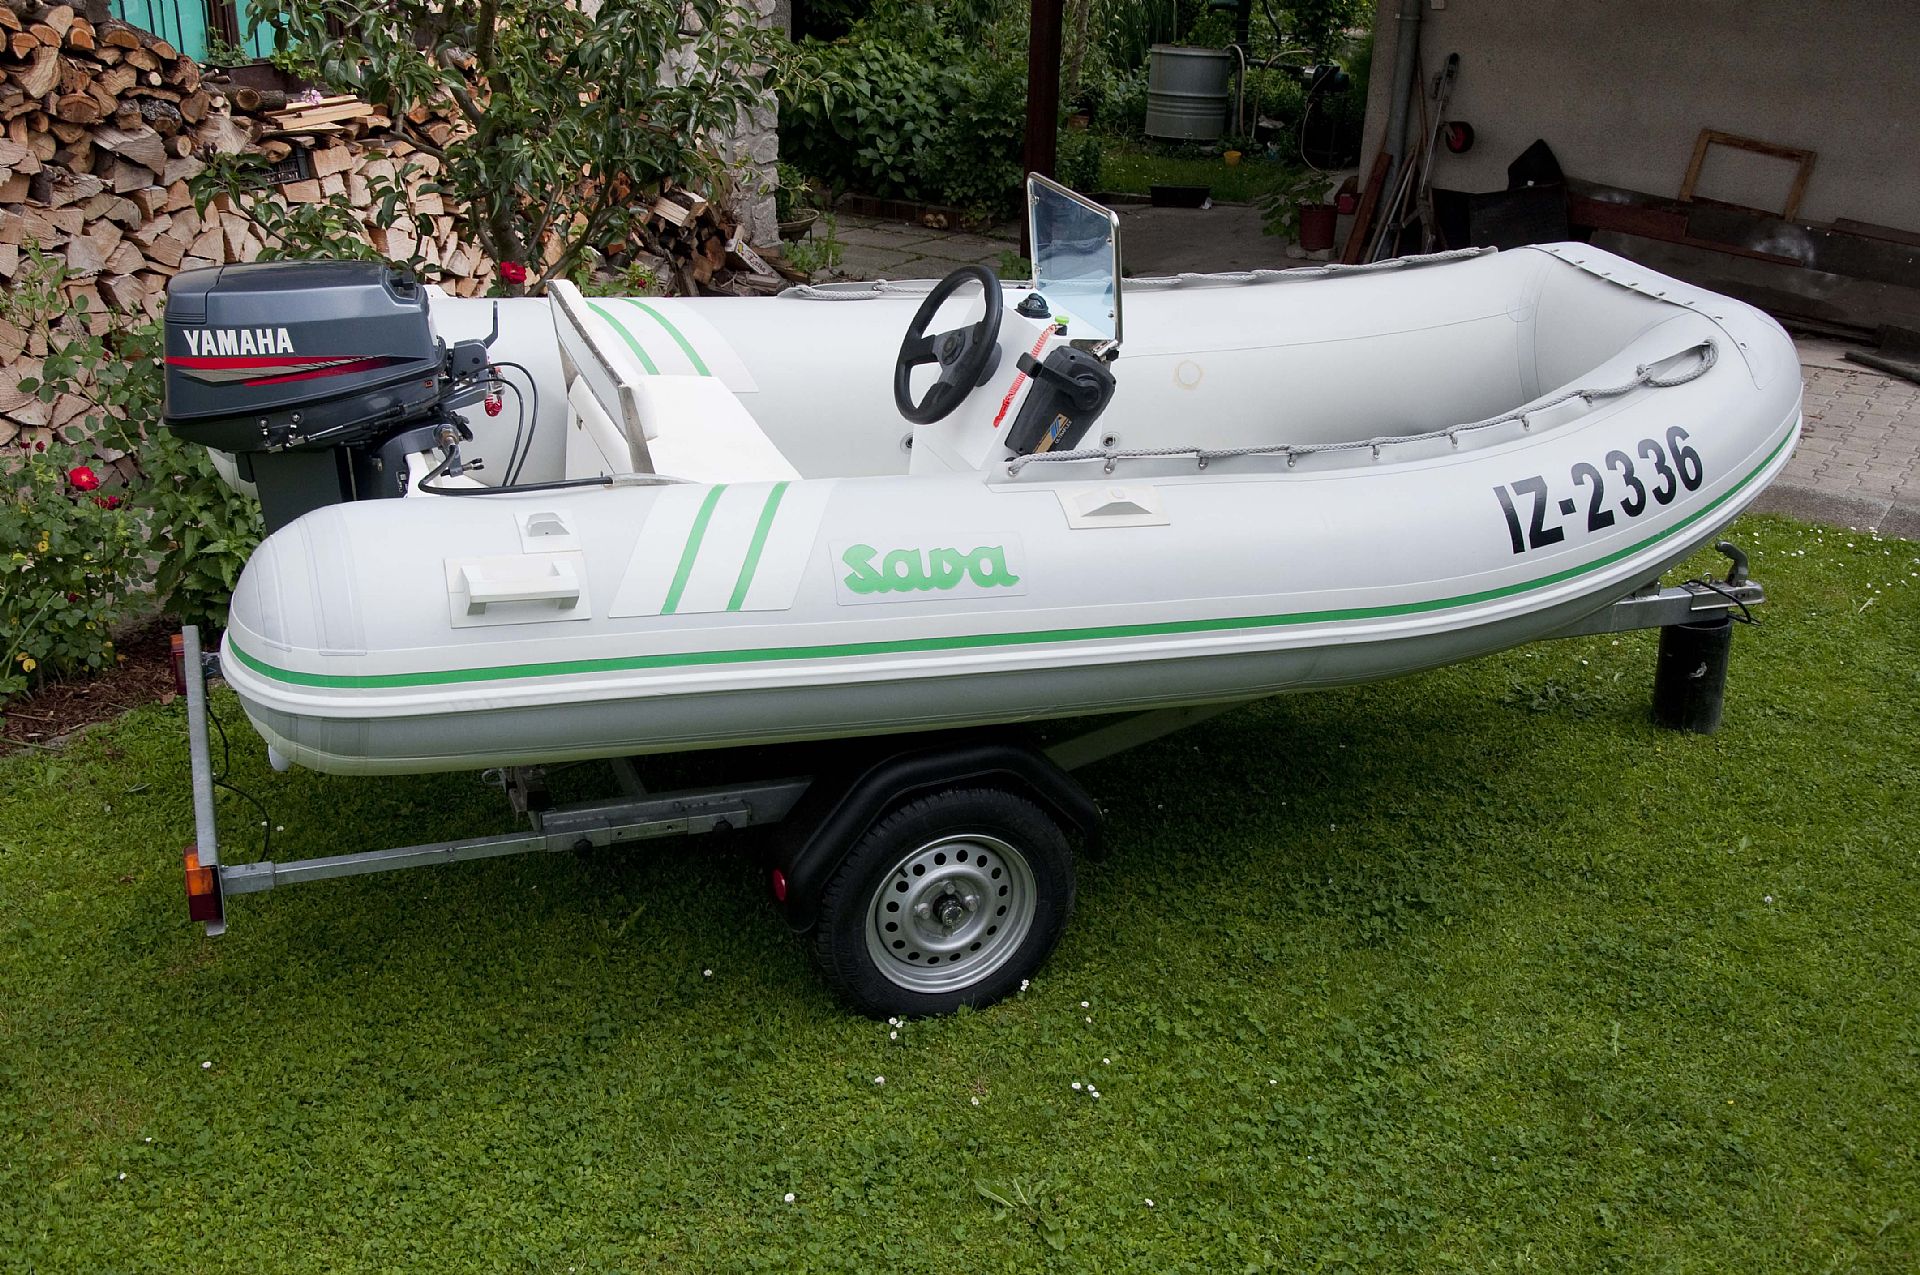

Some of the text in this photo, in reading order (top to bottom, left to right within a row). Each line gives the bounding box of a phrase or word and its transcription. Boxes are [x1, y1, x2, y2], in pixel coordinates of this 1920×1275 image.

[183, 328, 294, 356] YAMAHA
[1493, 426, 1703, 554] IZ-2336
[842, 544, 1020, 594] Sava
